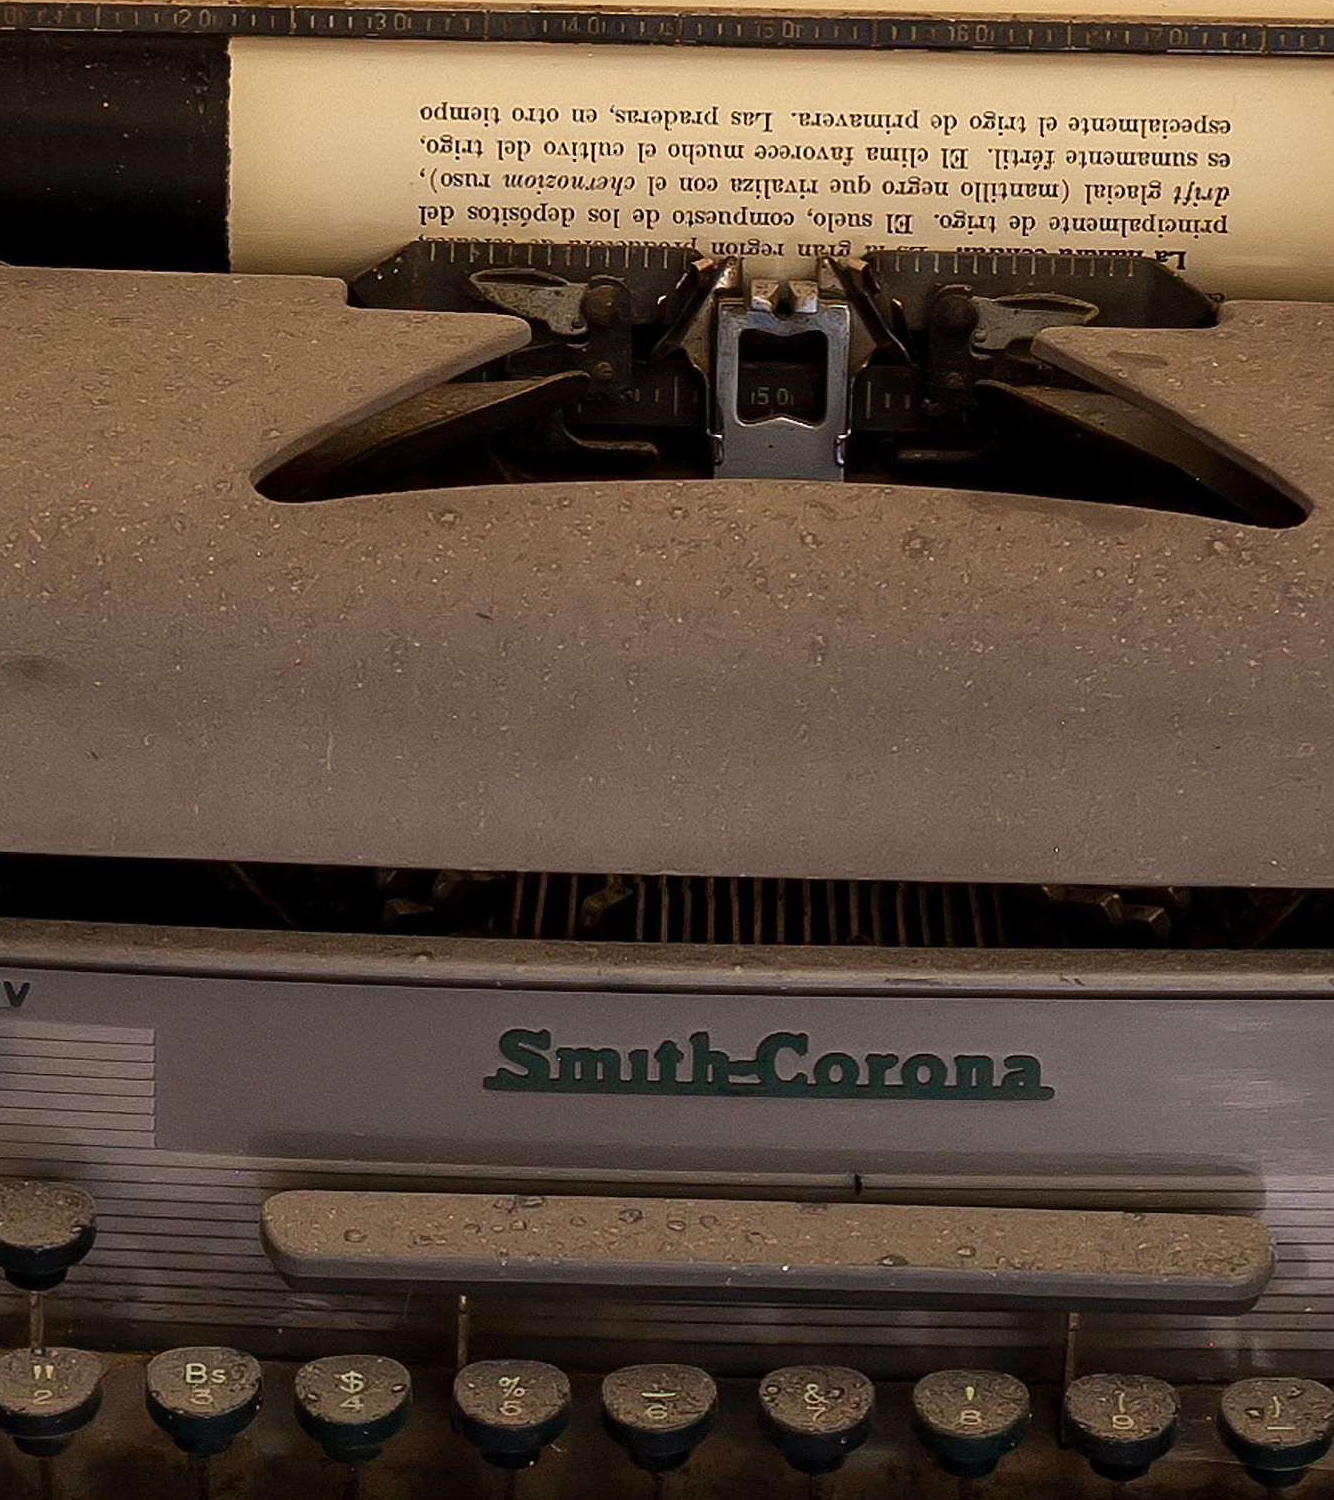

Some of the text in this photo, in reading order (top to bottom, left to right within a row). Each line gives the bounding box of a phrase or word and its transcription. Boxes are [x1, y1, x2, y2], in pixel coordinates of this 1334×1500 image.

[420, 102, 1231, 139] especialmente el trigo de primavera. Las praderas, en otro tiempo
[420, 135, 1230, 170] es sumamente fértil. El clima favorece mucho el cultivo del trigo,
[420, 168, 1229, 207] drift glacial (mantillo negro que rivaliza con el chernoziom ruso),
[418, 203, 1228, 239] principalmente de trigo. El suelo, compuesto de los depósitos del
[483, 1028, 1055, 1100] Smith-Corona
[185, 1362, 226, 1385] Bs
